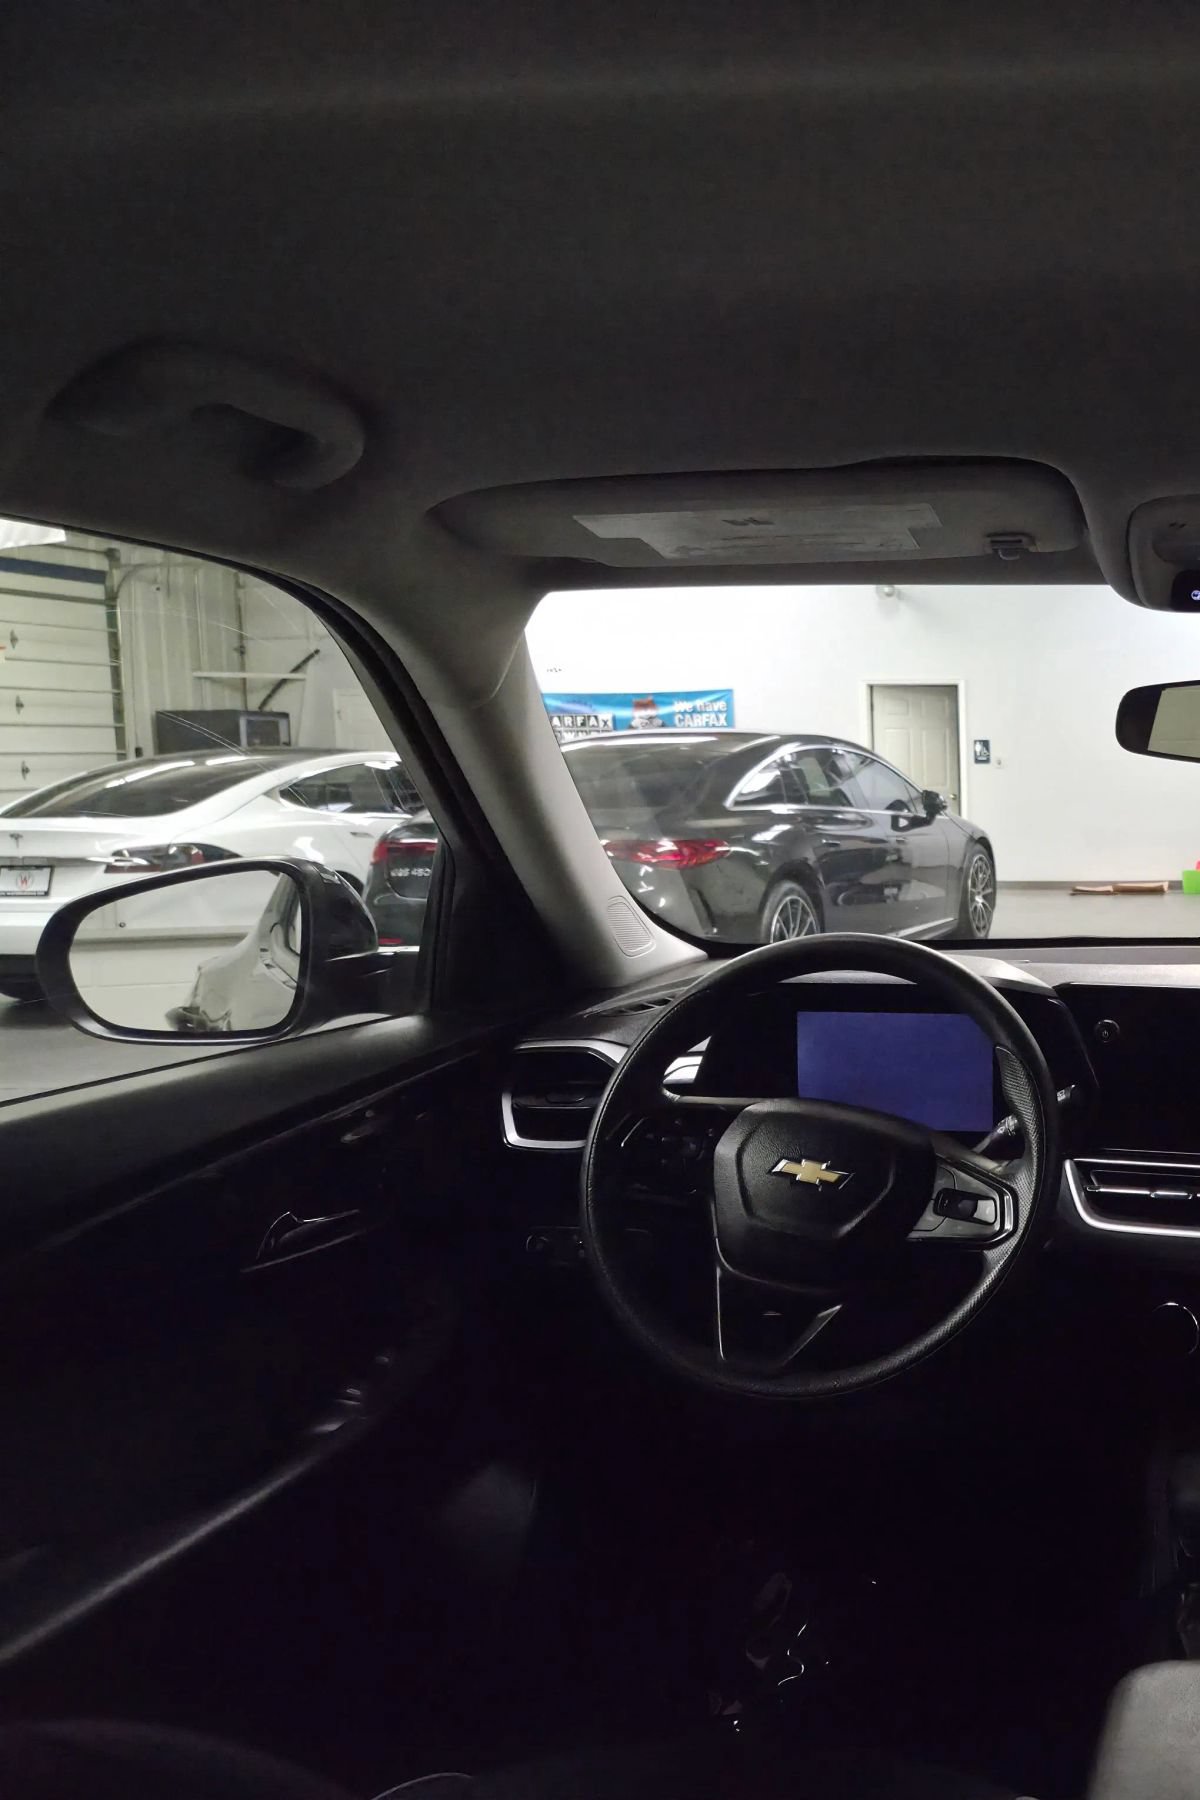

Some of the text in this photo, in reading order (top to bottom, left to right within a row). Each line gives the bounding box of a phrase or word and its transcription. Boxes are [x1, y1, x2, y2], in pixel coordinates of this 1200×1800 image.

[674, 700, 727, 712] We Have
[551, 715, 610, 728] ARFAX
[674, 712, 728, 728] CARFAX
